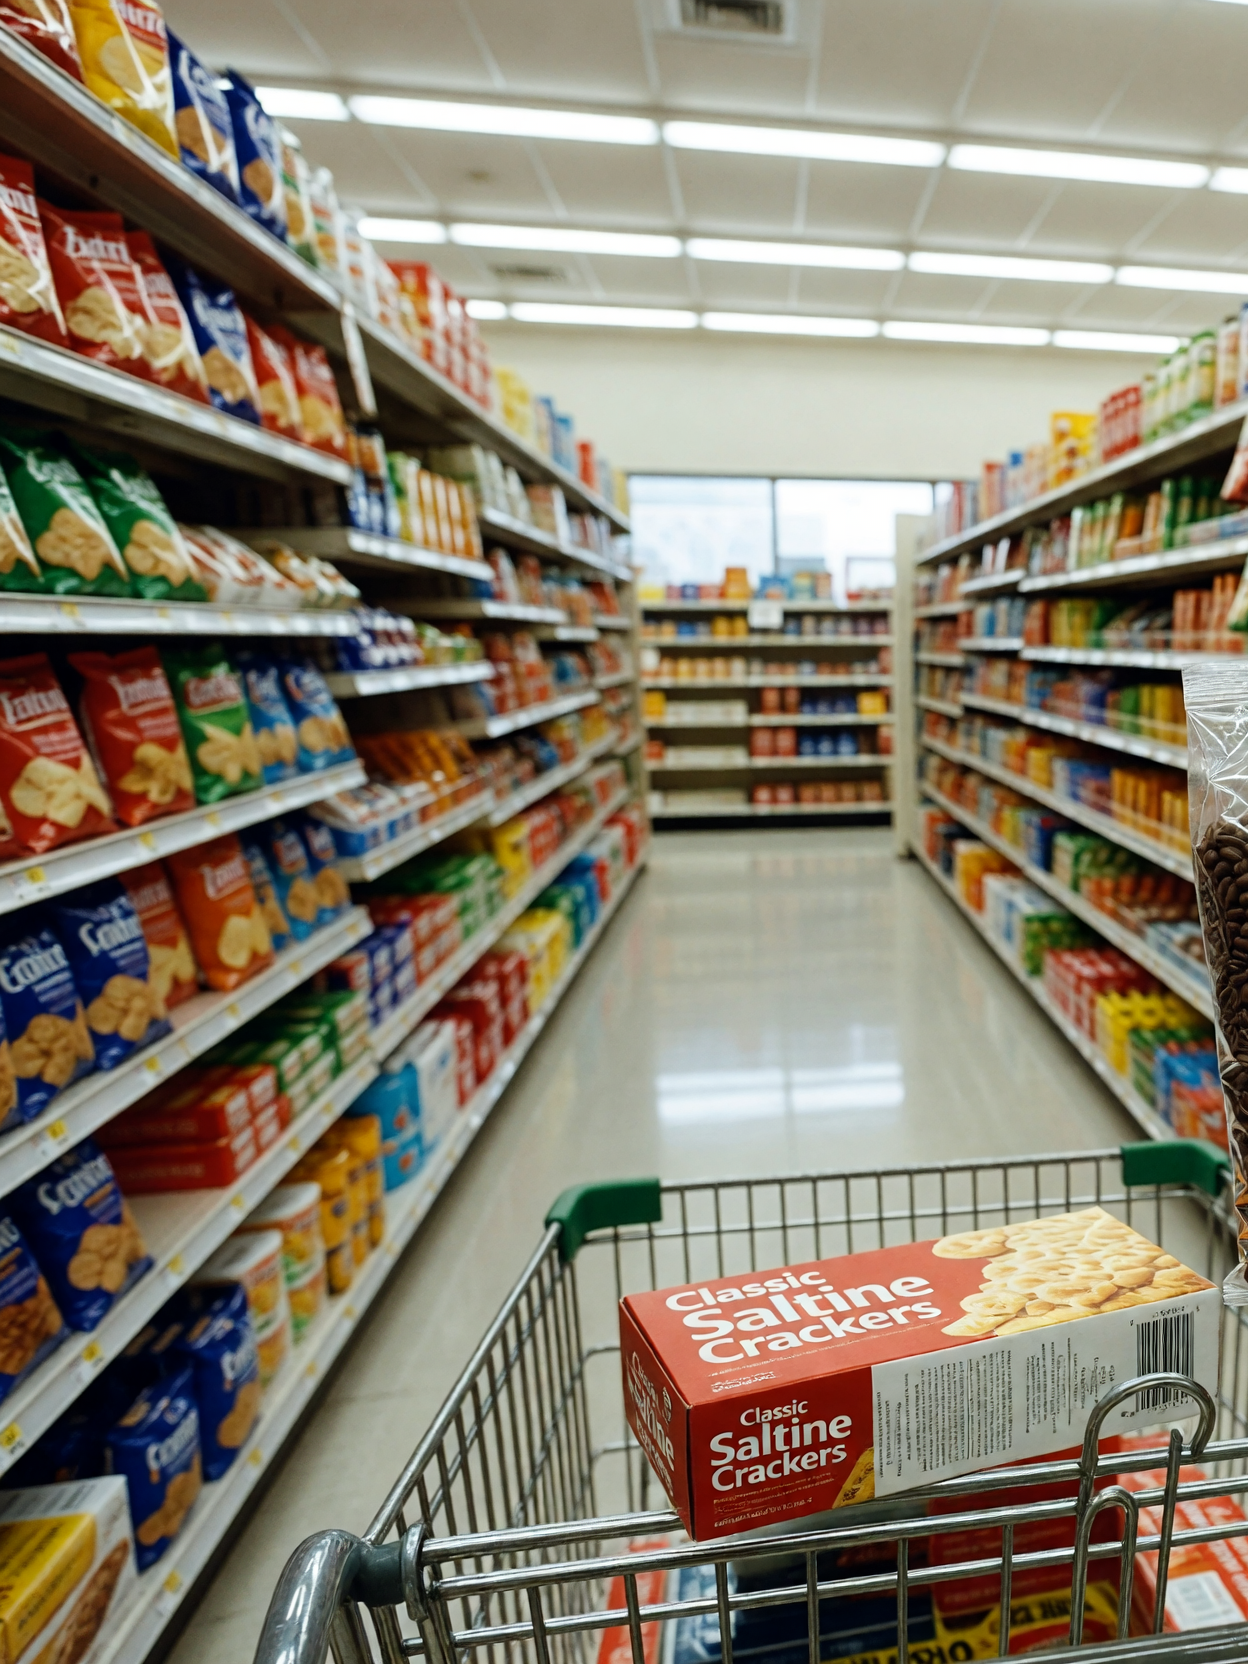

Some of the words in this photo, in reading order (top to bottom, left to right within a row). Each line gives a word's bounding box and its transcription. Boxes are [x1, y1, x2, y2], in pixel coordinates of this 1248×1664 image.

[665, 1270, 827, 1312] Classic
[682, 1275, 935, 1341] Saltine
[698, 1301, 943, 1365] Crackers
[739, 1399, 809, 1427] Classic
[709, 1413, 853, 1467] Saltine
[711, 1443, 848, 1493] Crackers
